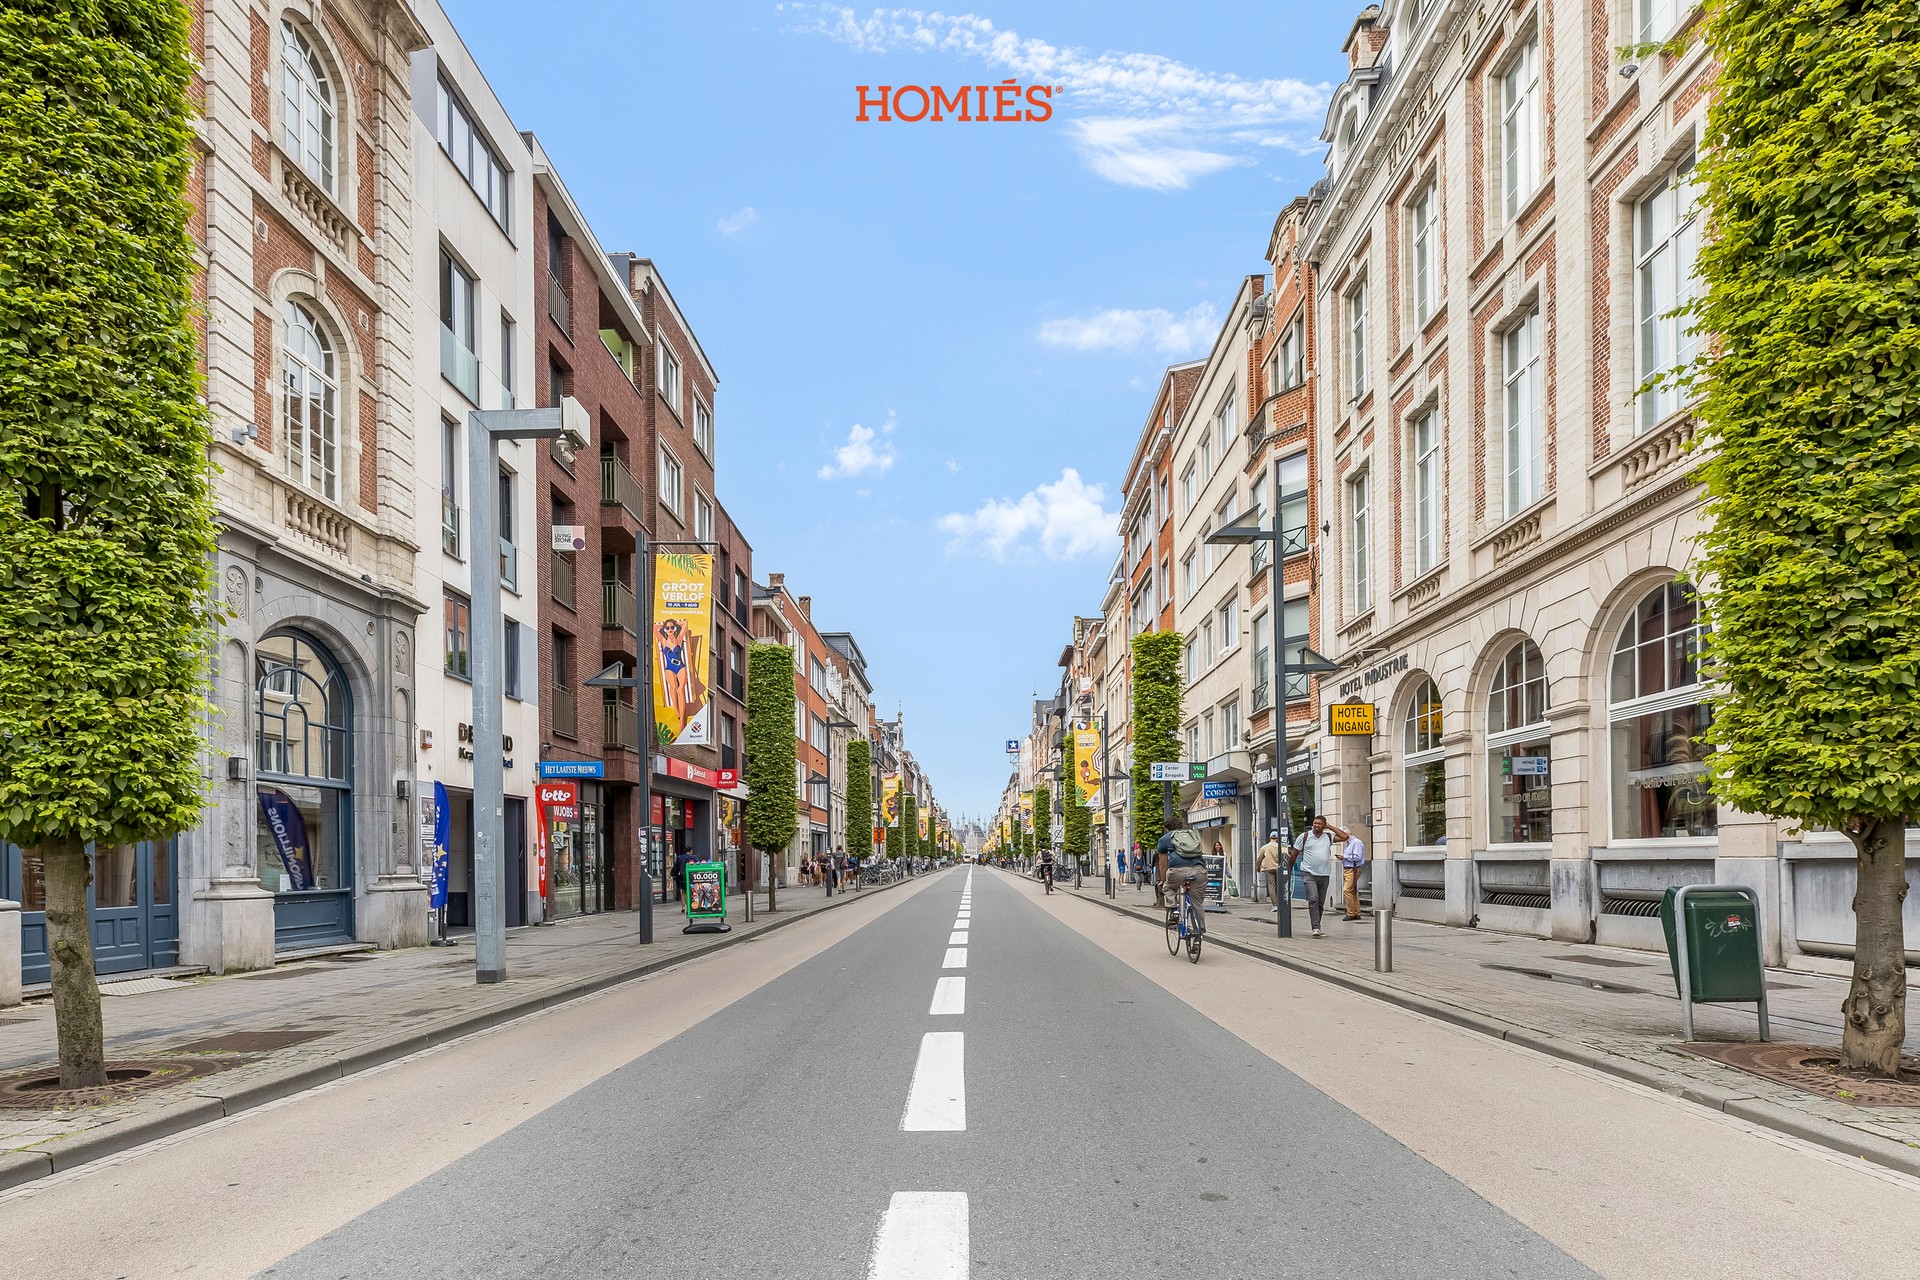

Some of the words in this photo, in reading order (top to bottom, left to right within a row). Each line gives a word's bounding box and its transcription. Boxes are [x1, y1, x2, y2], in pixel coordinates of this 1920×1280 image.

[1388, 83, 1438, 176] HOTEL
[661, 582, 705, 592] GROOT
[661, 592, 705, 601] VERLOF
[1339, 676, 1363, 698] HOTEL
[1364, 652, 1409, 687] INDUSTRIE
[1337, 707, 1368, 718] HOTEL
[1335, 721, 1371, 732] INGANG
[545, 765, 556, 774] HET
[556, 765, 577, 774] LAATSTE
[577, 765, 597, 774] NIEUWS
[1205, 789, 1236, 797] CORFOU
